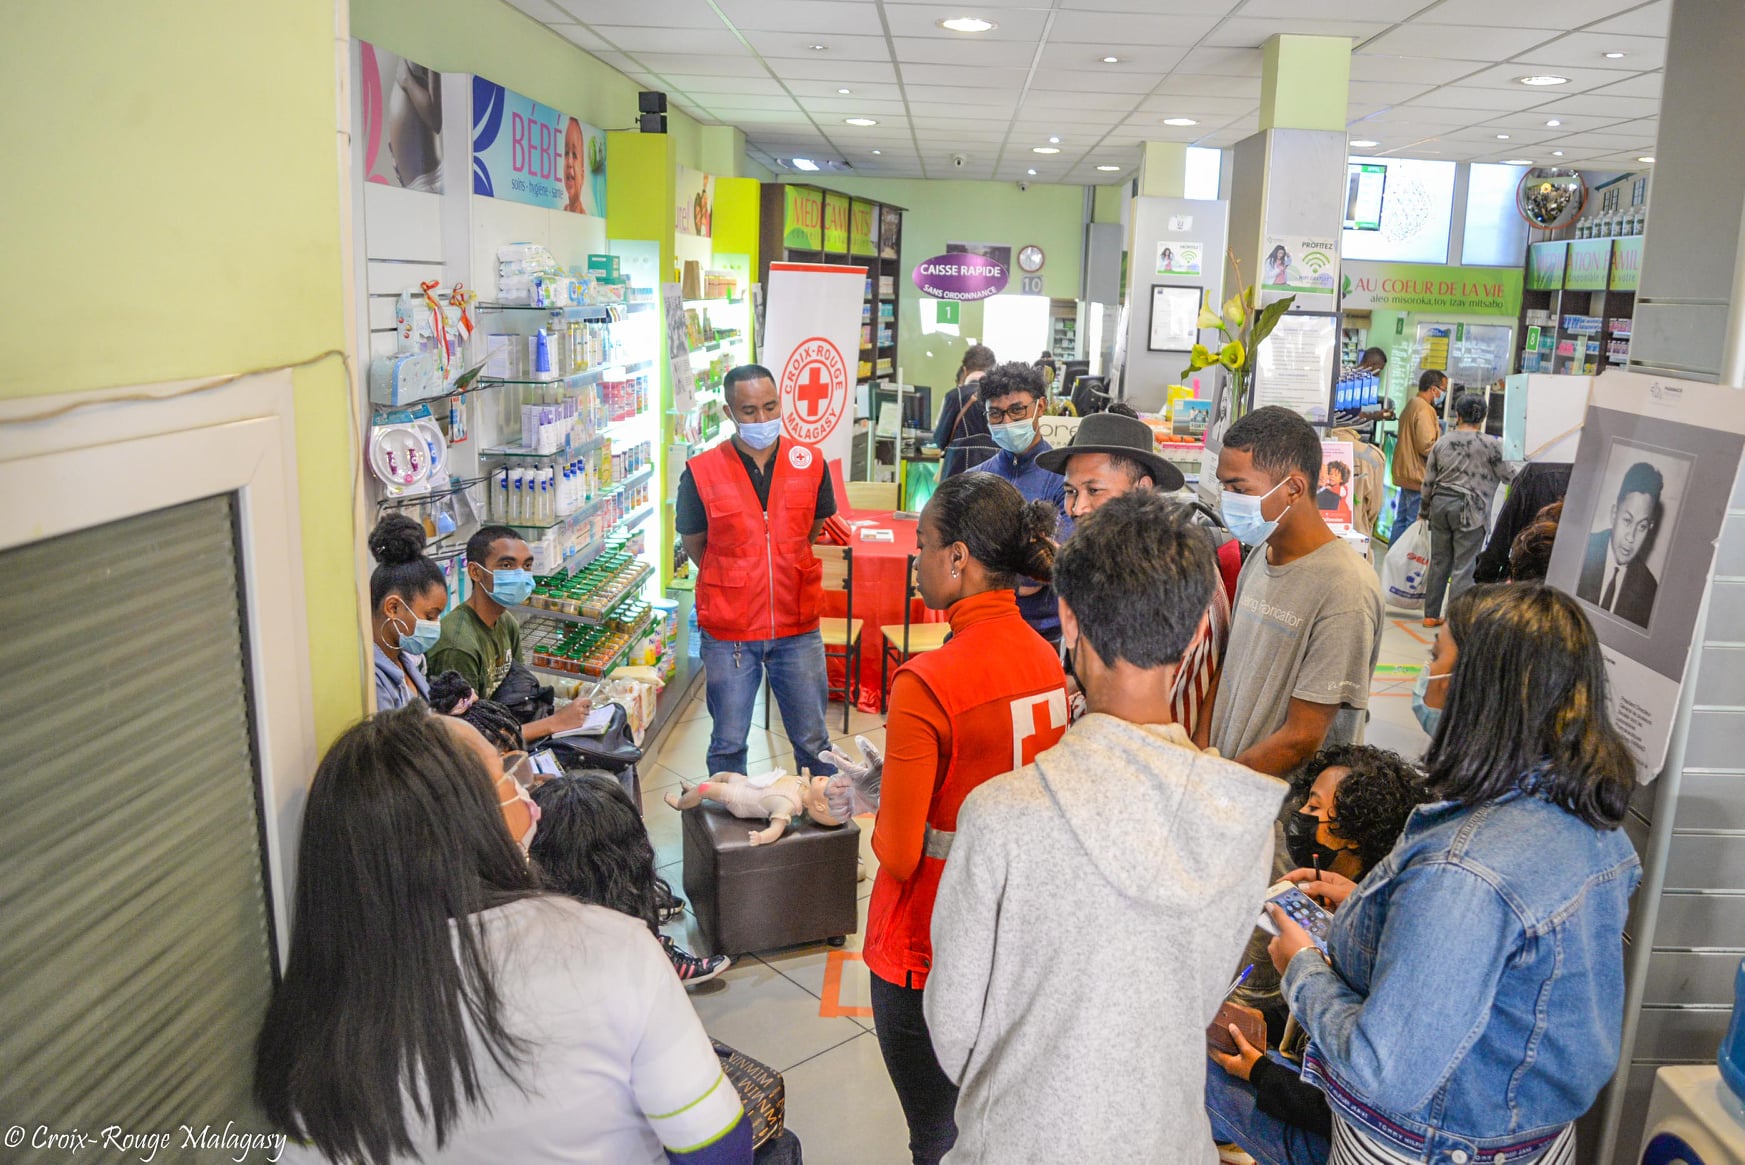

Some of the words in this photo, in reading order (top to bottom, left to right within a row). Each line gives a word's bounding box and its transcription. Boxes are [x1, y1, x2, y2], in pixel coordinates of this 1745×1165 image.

[511, 103, 563, 183] BÉBÉ
[1301, 241, 1333, 250] PROFITEZ
[920, 264, 958, 276] CAISSE
[960, 265, 1001, 277] RAPIDE
[922, 284, 943, 297] SANS
[943, 286, 997, 300] ORDONNANCE
[1023, 278, 1041, 292] 10
[1354, 277, 1378, 292] AU
[1381, 278, 1434, 296] COEUR
[1438, 281, 1456, 296] DE
[1462, 282, 1479, 297] LA
[1483, 283, 1505, 298] VIE
[1370, 293, 1390, 303] aleo
[945, 306, 951, 319] 1
[1529, 333, 1536, 346] 8
[784, 345, 843, 395] CROIX-ROUGE
[786, 407, 837, 440] MALAGASY
